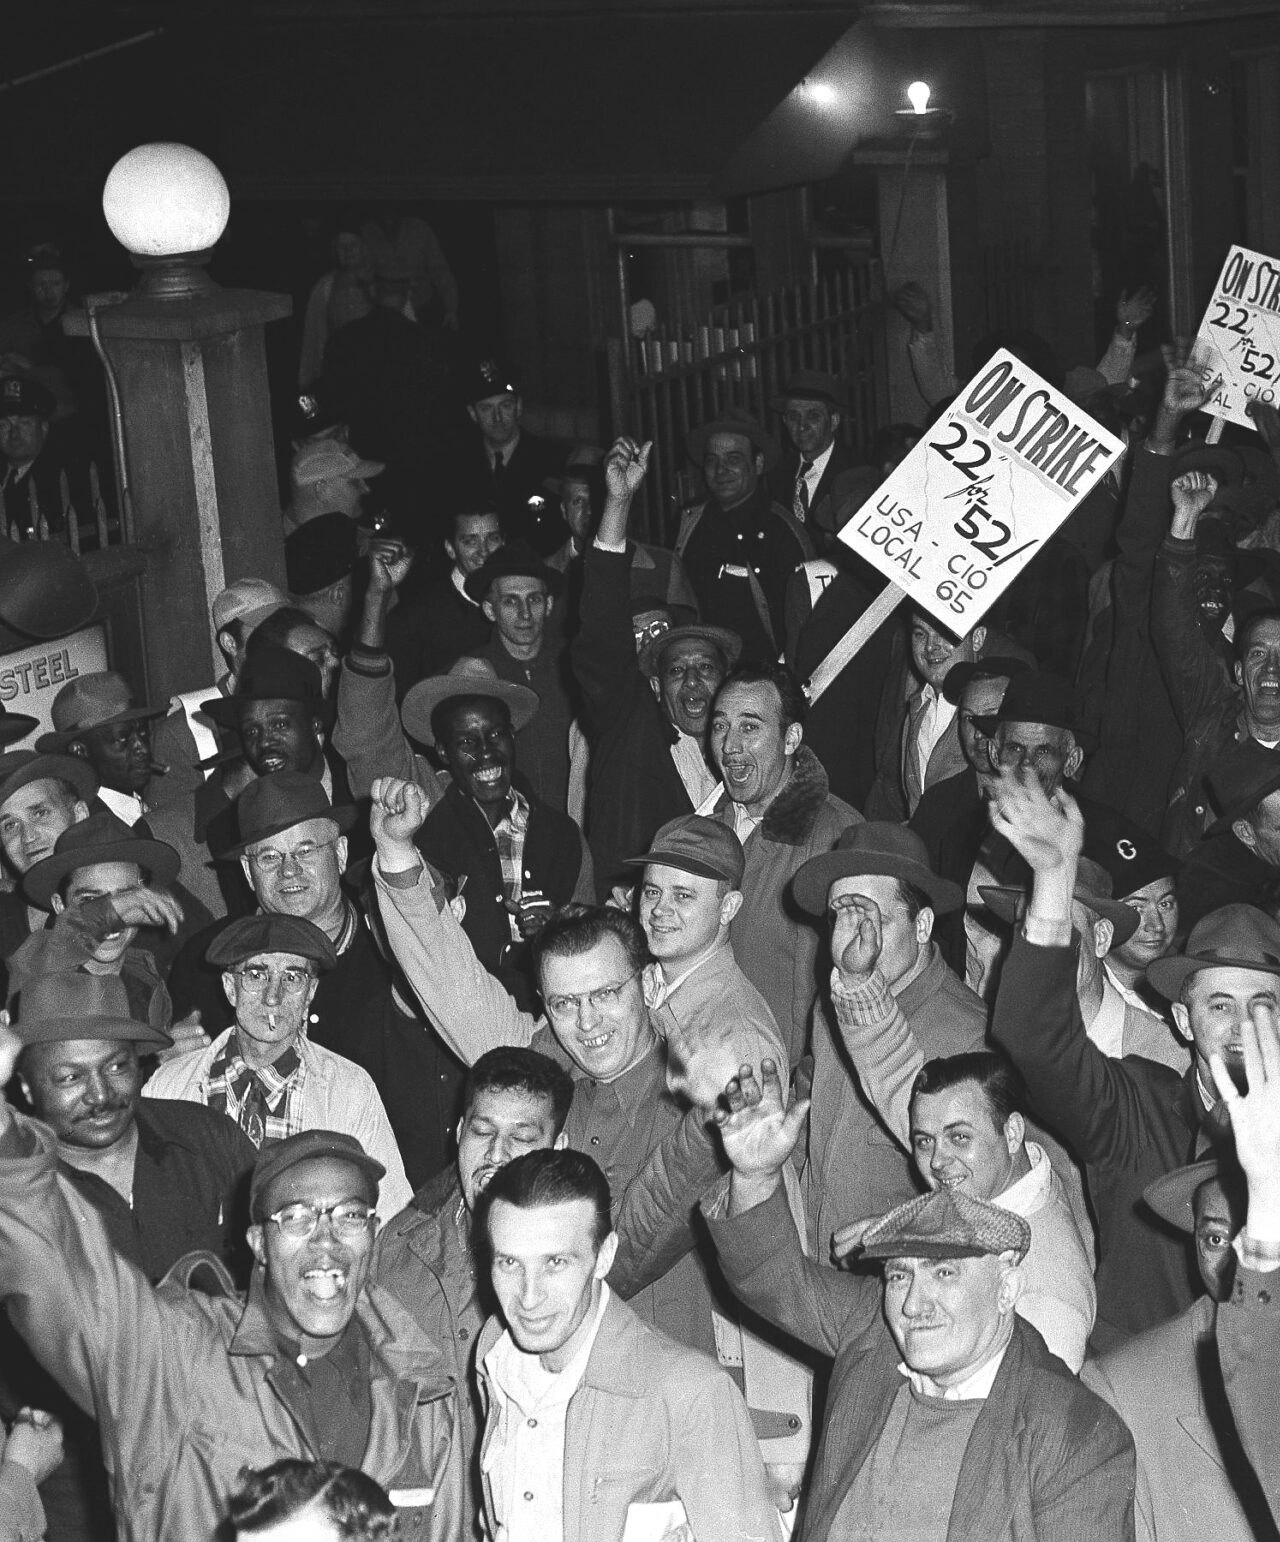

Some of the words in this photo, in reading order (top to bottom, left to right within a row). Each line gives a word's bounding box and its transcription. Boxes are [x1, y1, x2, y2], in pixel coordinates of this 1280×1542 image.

[1222, 252, 1255, 300] ON
[964, 360, 1026, 430] ON
[996, 389, 1113, 498] STRIKE
[1244, 382, 1275, 403] CIO
[857, 515, 921, 580] LOCAL
[935, 580, 973, 614] 65
[876, 494, 923, 543] USA
[947, 553, 988, 590] CIO
[0, 649, 79, 701] STEEL
